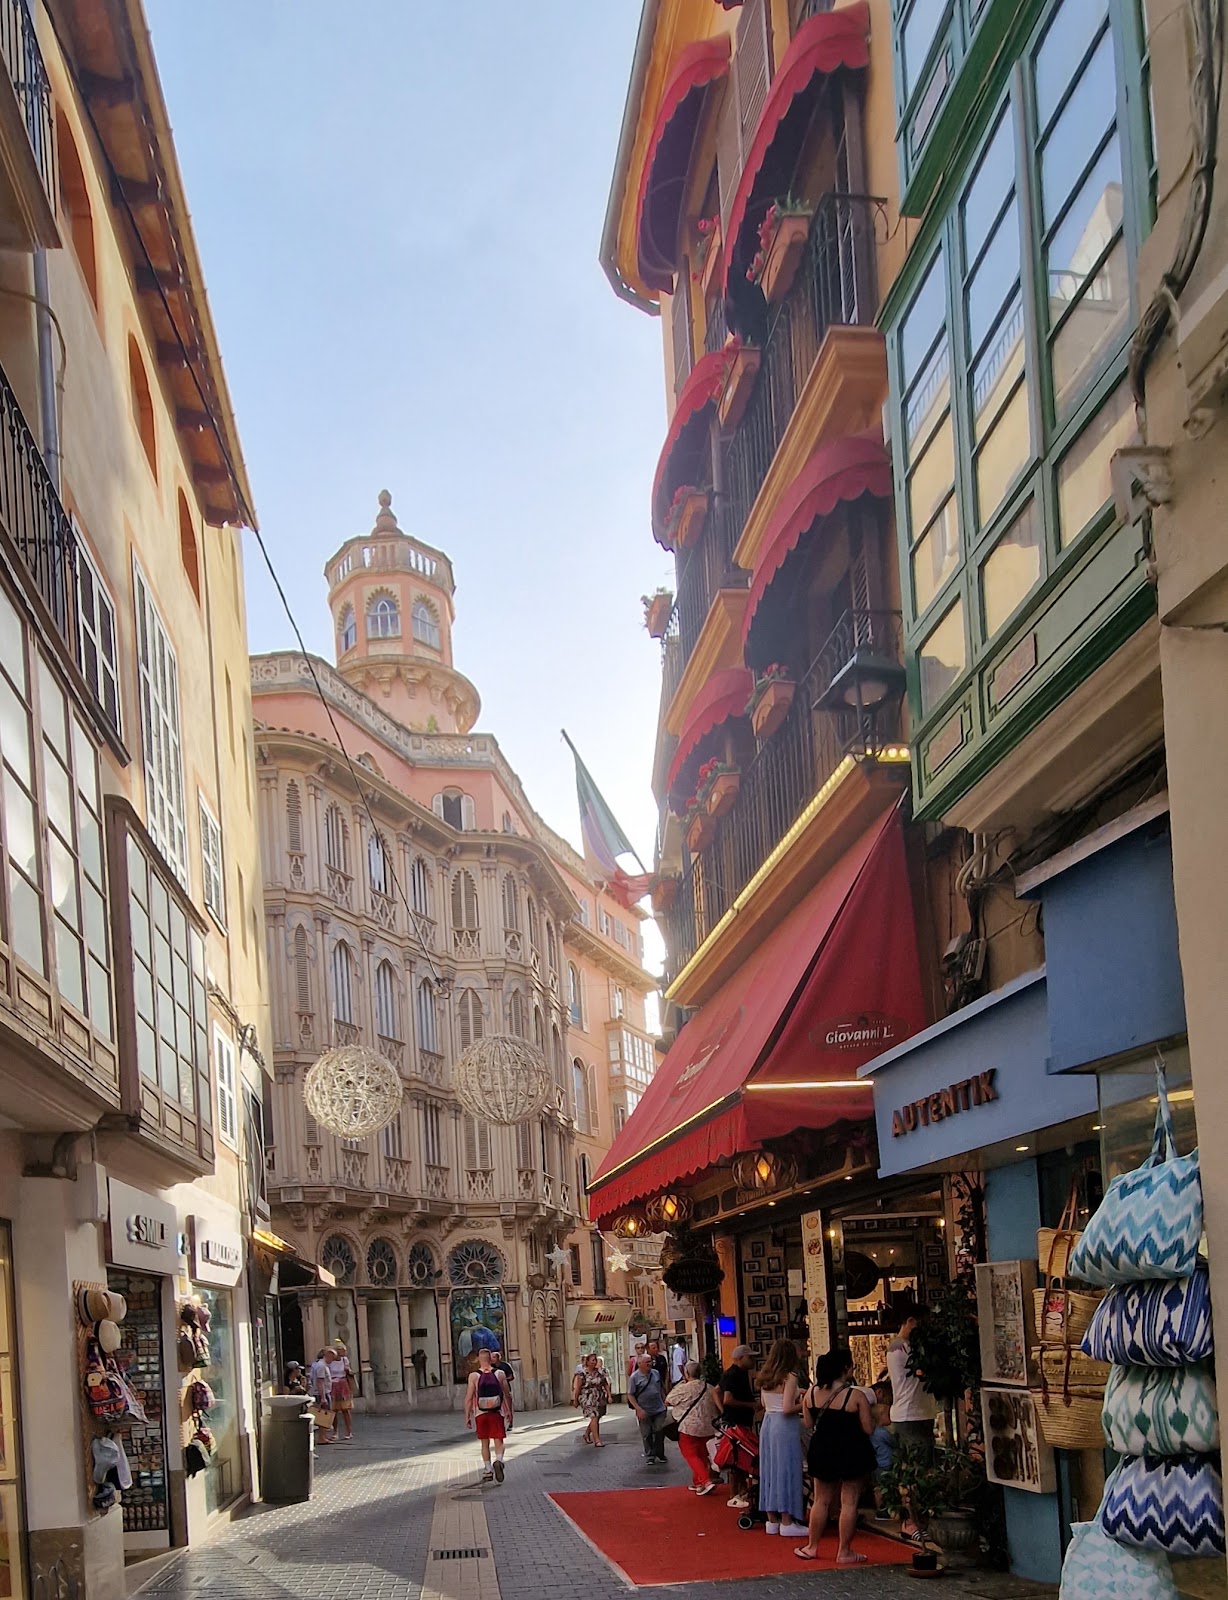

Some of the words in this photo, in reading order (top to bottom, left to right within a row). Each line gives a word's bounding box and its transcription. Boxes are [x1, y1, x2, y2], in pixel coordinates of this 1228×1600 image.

[825, 1026, 880, 1045] Giovanni
[892, 1068, 999, 1138] AUTENTIK
[128, 1214, 169, 1248] SMILE
